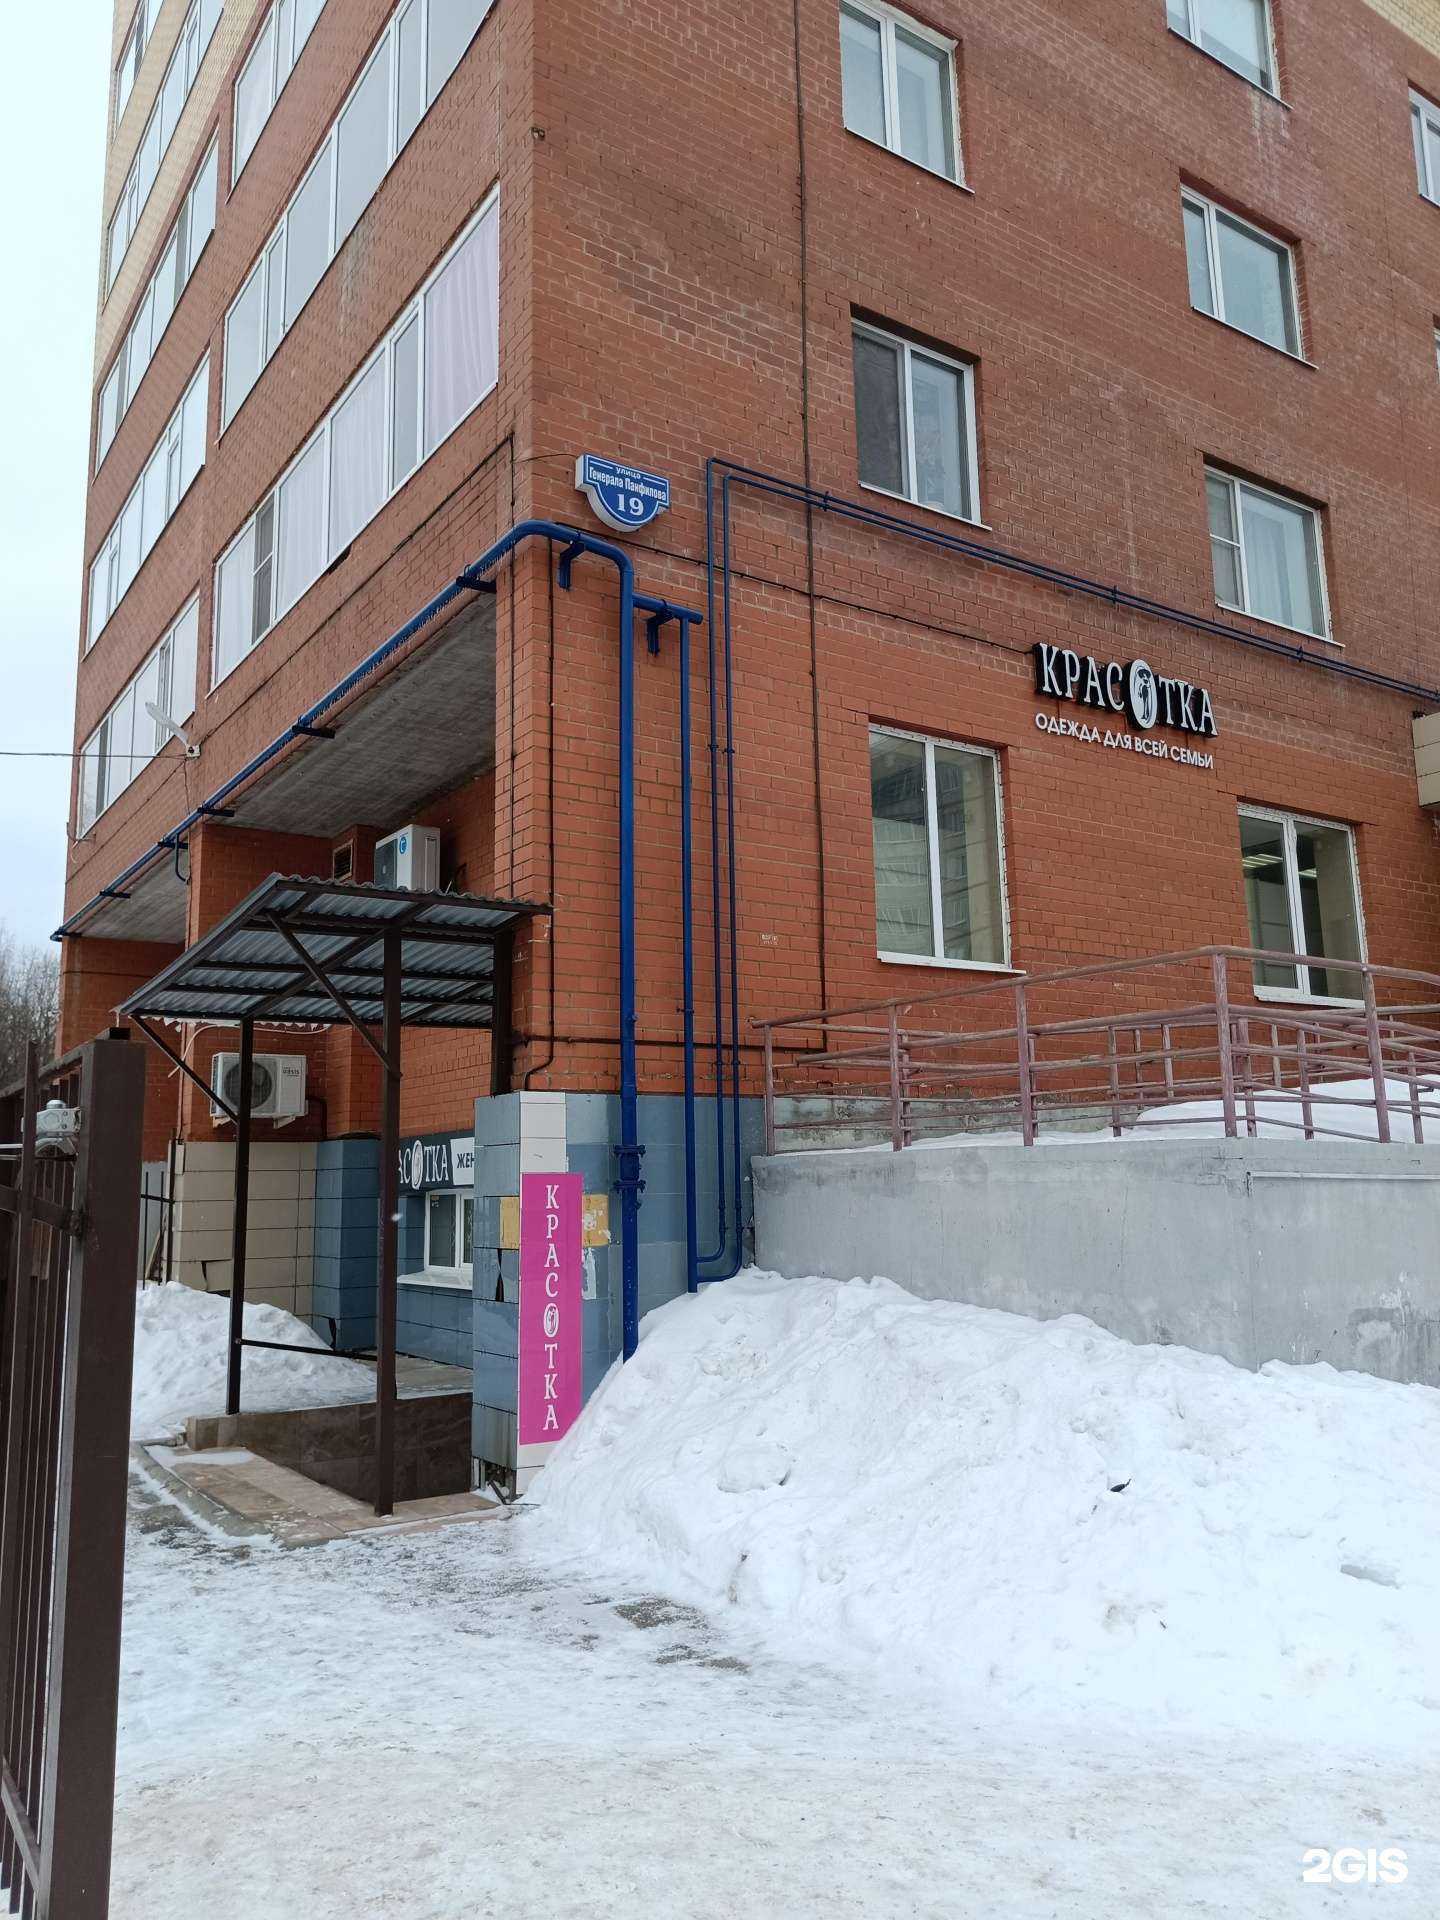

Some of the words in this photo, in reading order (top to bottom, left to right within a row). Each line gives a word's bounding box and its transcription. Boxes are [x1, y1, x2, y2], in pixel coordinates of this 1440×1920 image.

[589, 466, 624, 488] Генерала
[624, 477, 667, 501] Панфилова
[616, 494, 644, 516] 19
[1034, 642, 1219, 737] КРАСОТКА
[1035, 712, 1101, 743] ОДЕЖДА
[1103, 730, 1132, 748] ДЛЯ
[1134, 736, 1169, 759] ВСЕЙ
[1170, 746, 1215, 770] СЕМЬИ
[542, 1184, 560, 1431] КРАСОТКА
